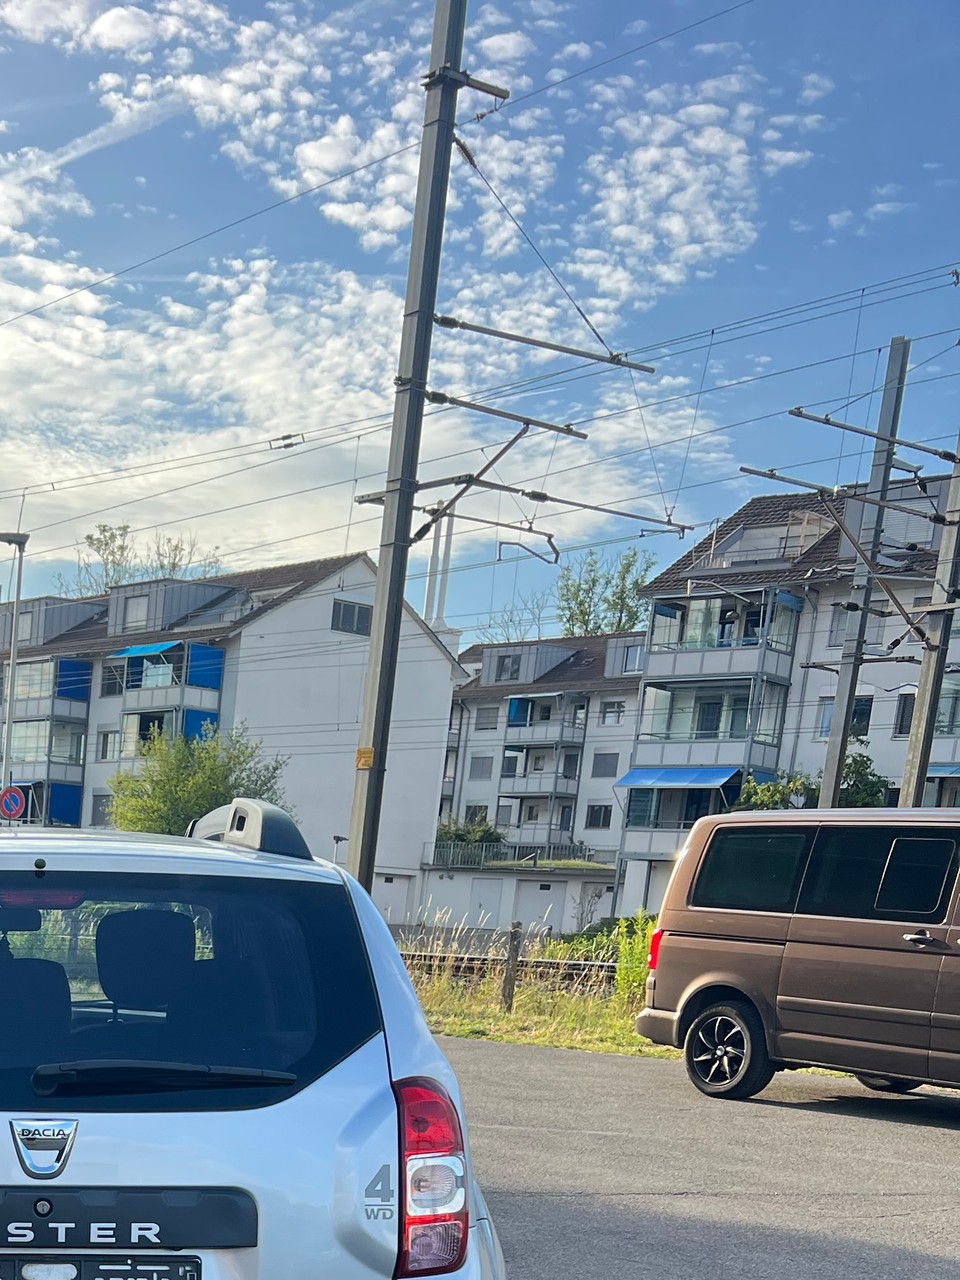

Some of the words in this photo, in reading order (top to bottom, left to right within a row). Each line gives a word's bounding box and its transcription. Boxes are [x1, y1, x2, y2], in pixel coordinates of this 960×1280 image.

[21, 1128, 67, 1137] DACIA
[365, 1164, 394, 1202] 4
[365, 1207, 394, 1220] WD
